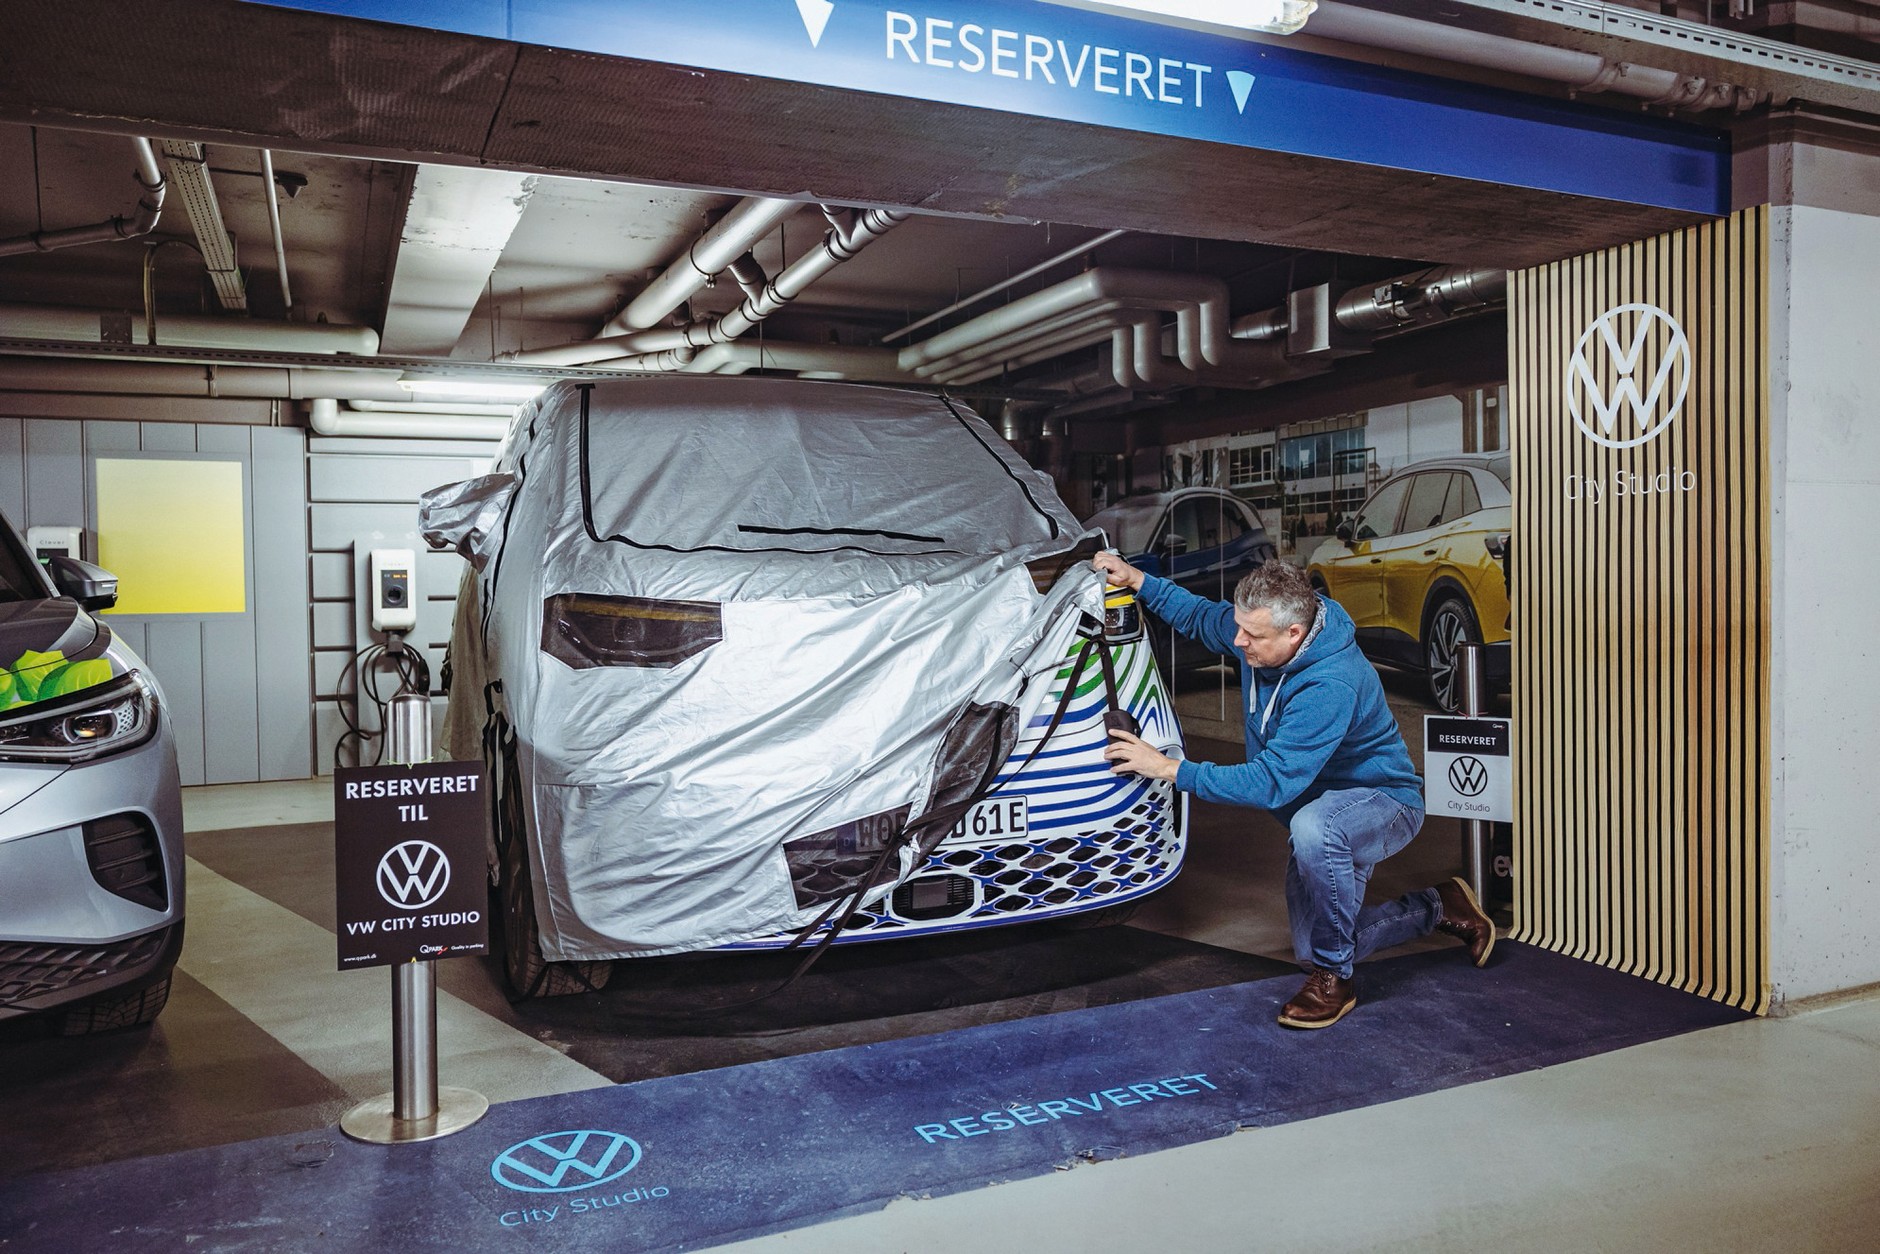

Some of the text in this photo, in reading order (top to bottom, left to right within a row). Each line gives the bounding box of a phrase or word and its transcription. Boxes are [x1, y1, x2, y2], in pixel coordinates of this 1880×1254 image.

[886, 10, 1212, 108] RESERVERET
[1565, 466, 1696, 504] City Studio
[1439, 734, 1496, 746] RESERVERET
[345, 775, 479, 799] RESERVERET
[398, 805, 429, 822] TIL
[1447, 801, 1491, 812] City Studio
[346, 911, 481, 936] VW CITY STUDIO
[913, 1073, 1218, 1144] RESERVERET
[499, 1186, 670, 1227] City Studio
